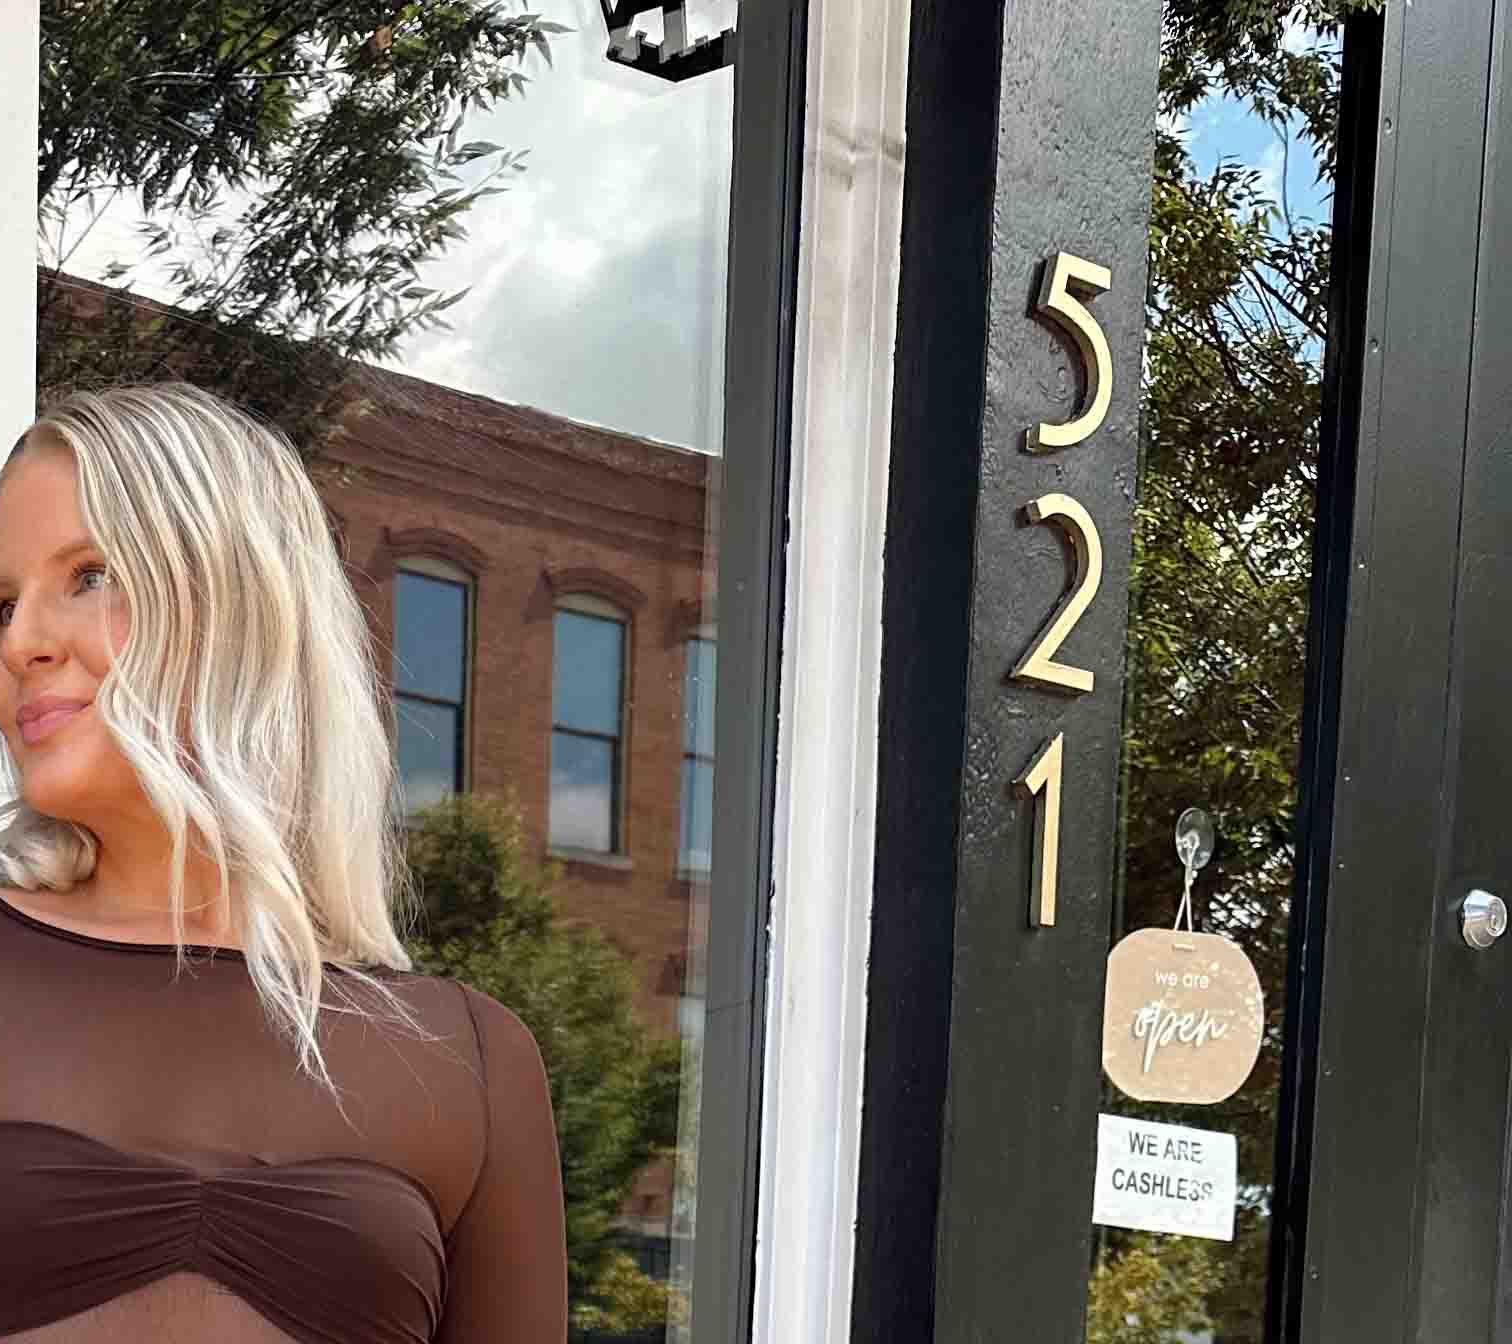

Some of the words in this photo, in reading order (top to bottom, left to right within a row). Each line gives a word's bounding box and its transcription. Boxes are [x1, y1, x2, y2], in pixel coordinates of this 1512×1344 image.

[1007, 250, 1114, 928] 521
[1155, 970, 1178, 988] we
[1183, 973, 1210, 990] are
[1133, 1001, 1226, 1074] open
[1128, 1131, 1159, 1158] WE
[1163, 1137, 1203, 1163] ARE
[1111, 1168, 1213, 1202] CASHLESS
